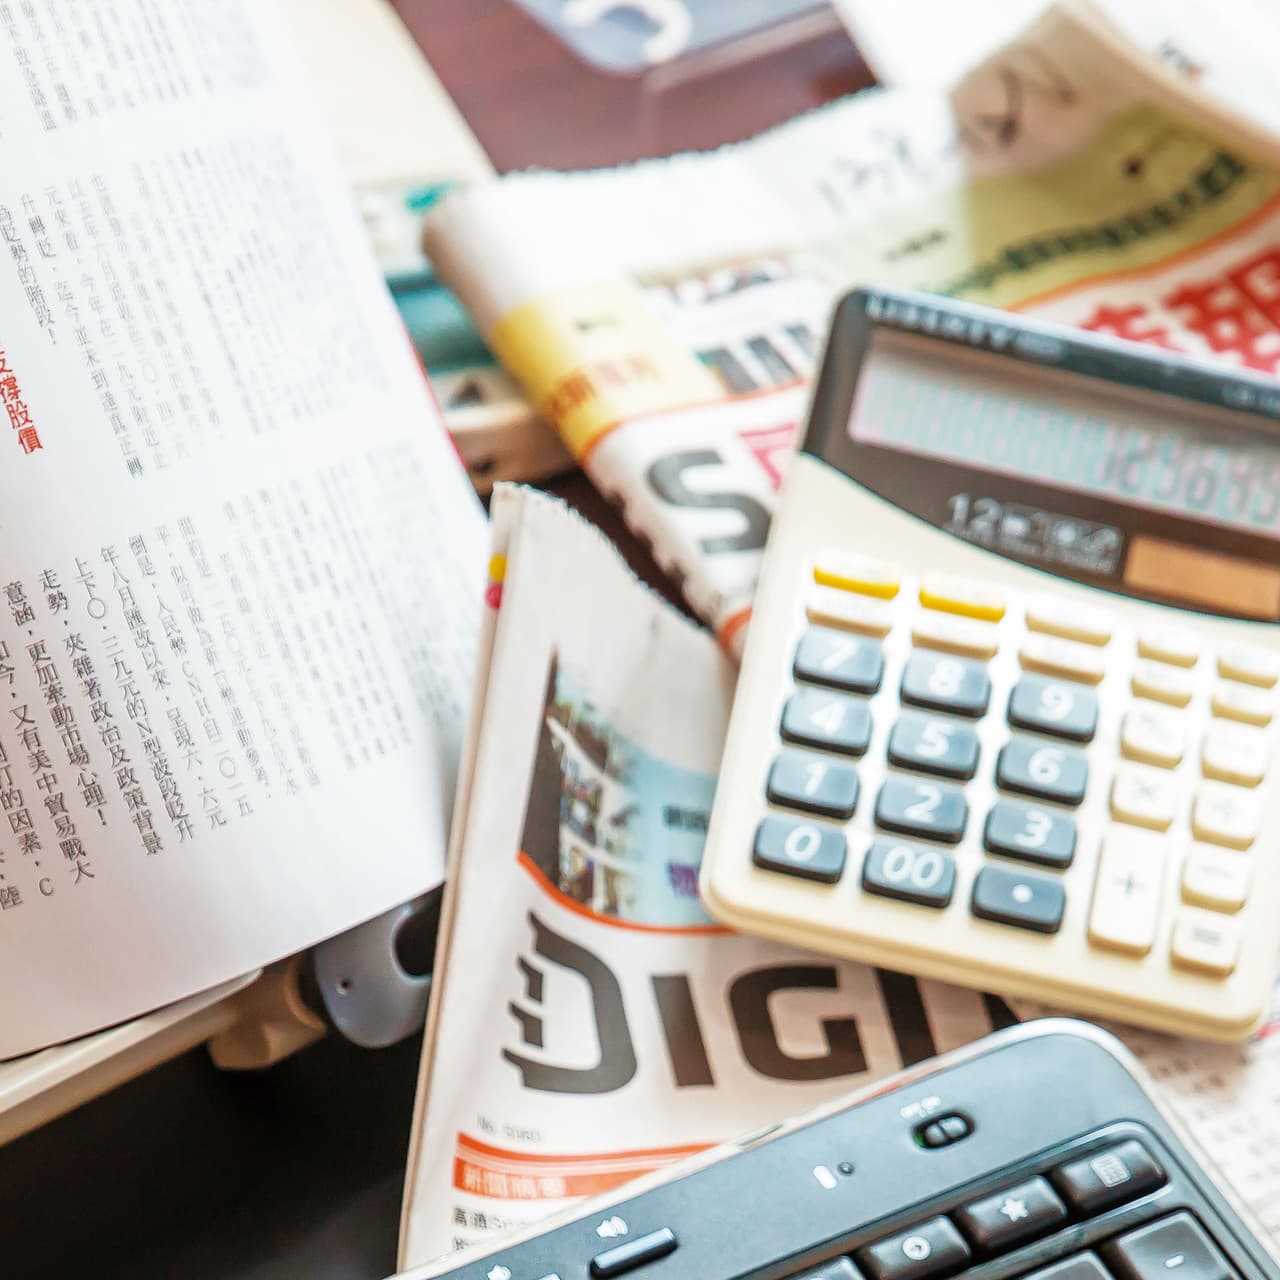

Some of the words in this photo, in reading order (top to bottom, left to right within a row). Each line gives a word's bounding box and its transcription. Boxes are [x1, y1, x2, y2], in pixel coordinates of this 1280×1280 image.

[823, 641, 858, 668] 7
[927, 663, 964, 694] 8
[811, 702, 843, 732] 4
[1039, 689, 1074, 721] 9
[919, 725, 951, 757] 5
[803, 762, 828, 793] 1
[1027, 750, 1060, 783] 6
[905, 787, 940, 820] 2
[785, 826, 819, 863] 0
[1017, 812, 1051, 846] 3
[881, 846, 944, 889] 00
